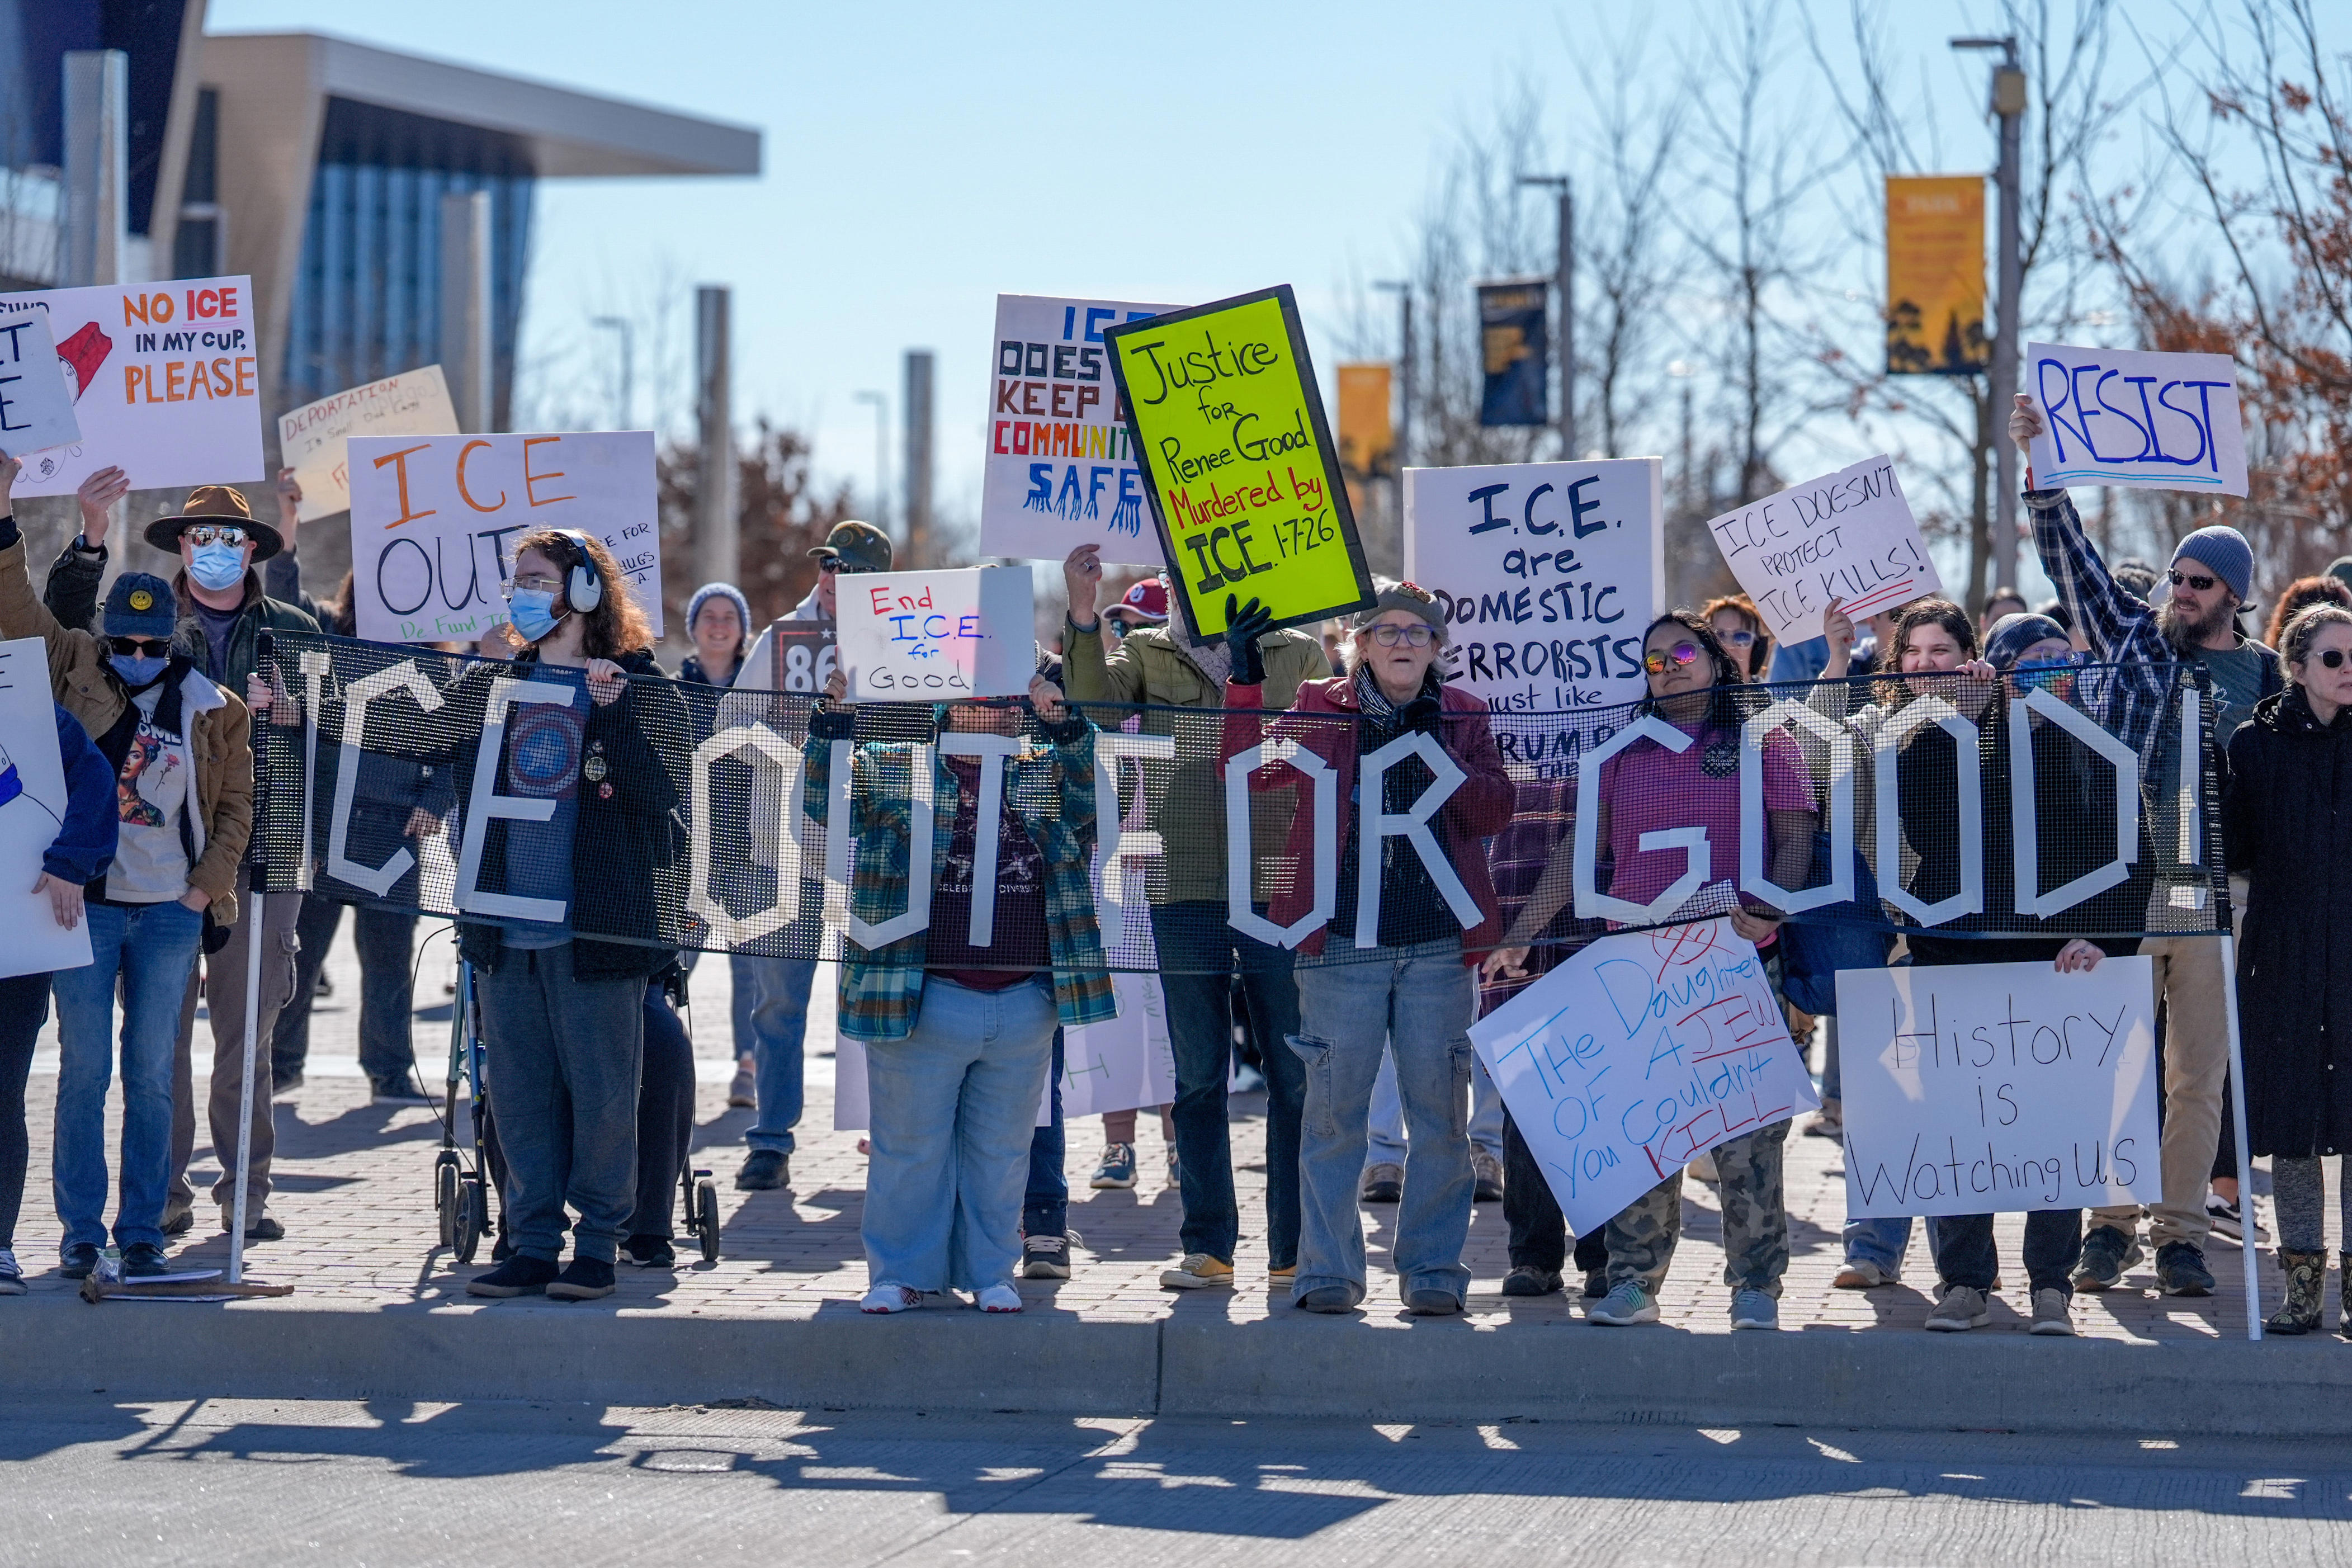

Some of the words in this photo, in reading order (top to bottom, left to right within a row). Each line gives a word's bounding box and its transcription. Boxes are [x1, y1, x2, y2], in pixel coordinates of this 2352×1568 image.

[123, 292, 174, 327] NO
[186, 287, 237, 321] ICE
[1062, 306, 1156, 342] IC
[136, 333, 155, 352] IN
[162, 332, 197, 352] MY
[201, 329, 246, 351] CUP,
[999, 340, 1103, 381] DOES
[125, 357, 255, 404] PLEASE
[1130, 330, 1278, 405] Justice
[285, 378, 398, 442] DEPORTATION
[996, 379, 1099, 419] KEEP
[2038, 358, 2230, 472] RESIST
[994, 421, 1138, 461] COMMUNIT
[1159, 436, 1235, 485] Renee
[1232, 408, 1311, 462] Good
[373, 436, 577, 530] ICE
[1023, 463, 1142, 528] SAFE
[1169, 470, 1284, 530] Murdered
[1288, 466, 1323, 512] by
[1468, 474, 1622, 539] I.C.E.
[1792, 465, 1896, 528] DOESN'T
[622, 523, 651, 540] FOR
[1760, 526, 1842, 577] PROTECT
[376, 523, 530, 615] OUT
[1503, 547, 1583, 579] are
[870, 586, 933, 615] End
[1434, 580, 1624, 625] DOMESTIC
[889, 615, 993, 641] I.C.E.
[908, 644, 939, 660] for
[1486, 683, 1541, 714] just
[1555, 685, 1603, 709] like
[1496, 726, 1616, 765] RUMP
[296, 650, 575, 923] ICE
[686, 720, 1031, 952] OUT
[1094, 730, 1485, 951] FOR
[1892, 993, 2126, 1068] History
[1554, 1065, 1612, 1140] OF
[1646, 1026, 1685, 1080] A
[1676, 980, 1777, 1055] JEW
[1643, 1092, 1792, 1180] KILL
[1846, 1132, 2061, 1206] Watching
